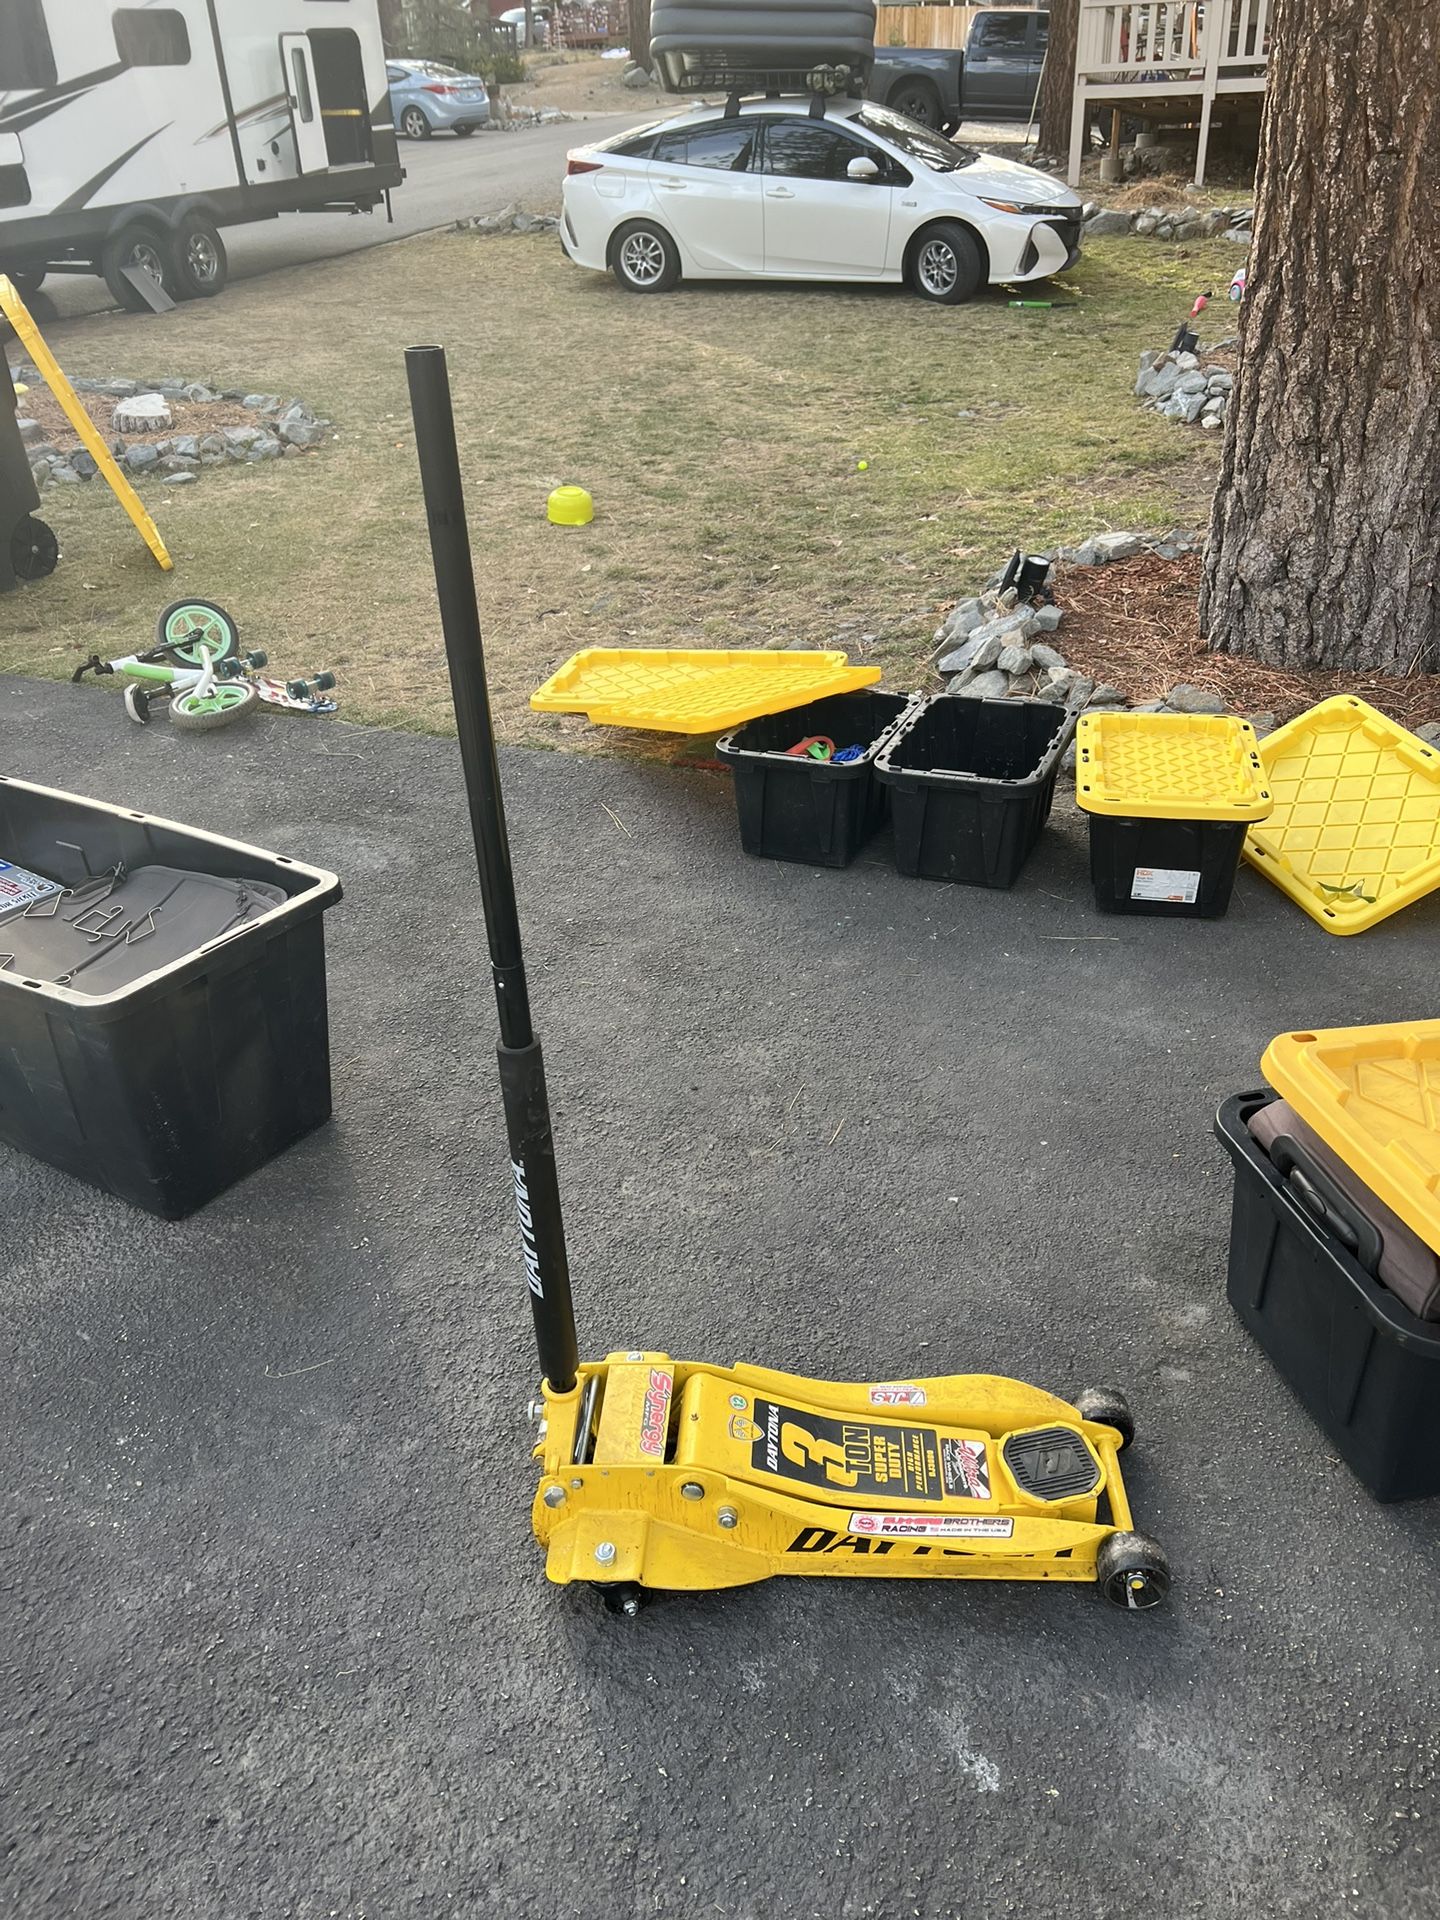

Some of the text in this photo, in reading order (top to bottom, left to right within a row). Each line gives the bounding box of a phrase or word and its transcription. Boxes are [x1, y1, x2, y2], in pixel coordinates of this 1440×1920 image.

[640, 1366, 674, 1456] Synergy
[766, 1404, 779, 1472] DAYTONA
[781, 1422, 872, 1488] 3 TON
[873, 1435, 888, 1483] SUPER
[887, 1442, 902, 1479] DUTY
[906, 1451, 914, 1472] HIGH
[912, 1434, 923, 1491] PERFORMANCE
[881, 1525, 928, 1533] RACING
[943, 1518, 1010, 1526] BROTHERS
